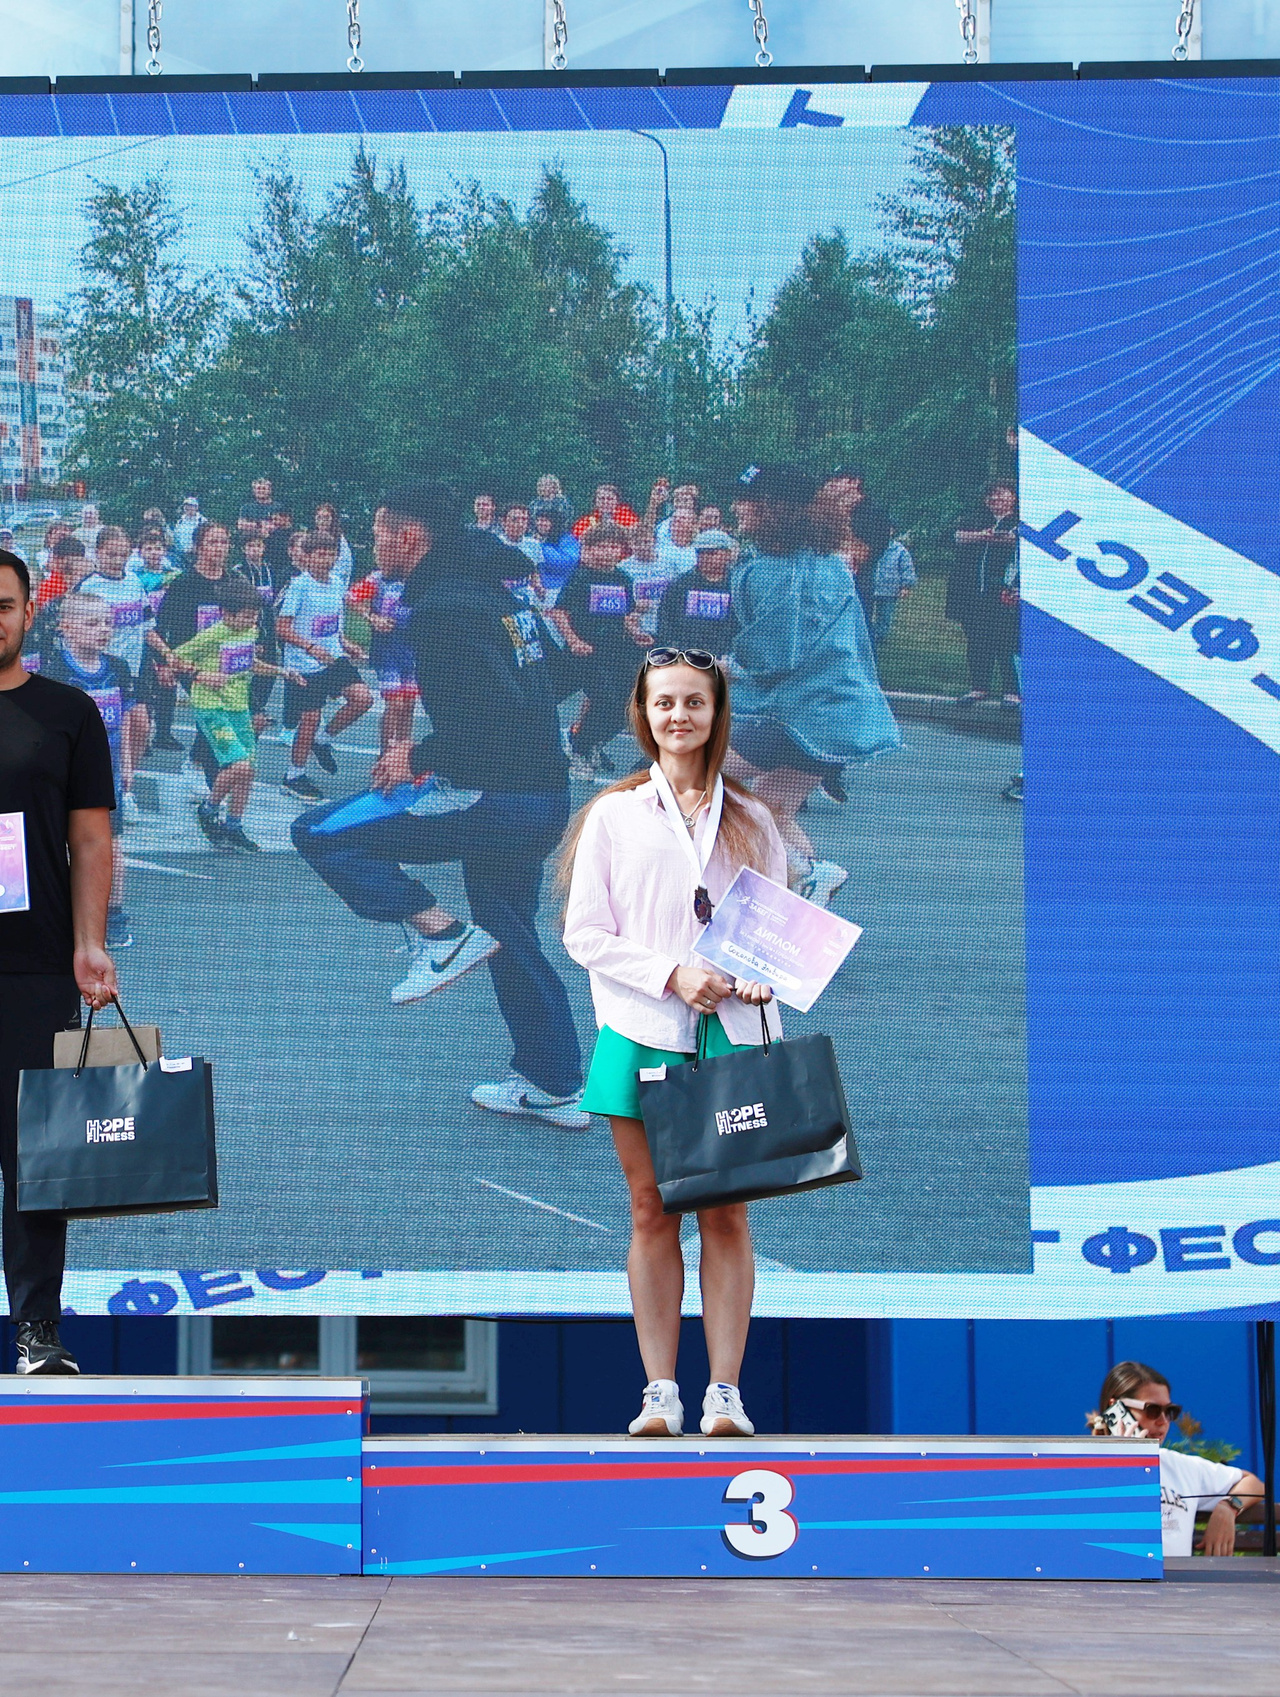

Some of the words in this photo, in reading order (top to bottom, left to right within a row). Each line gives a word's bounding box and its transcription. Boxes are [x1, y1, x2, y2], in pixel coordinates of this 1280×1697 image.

[753, 926, 802, 957] ДИПЛОМ
[86, 1116, 136, 1134] HOPE
[715, 1102, 767, 1128] HOPE
[86, 1131, 136, 1144] FITNESS
[717, 1118, 768, 1136] FITNESS
[721, 1469, 799, 1561] 3
